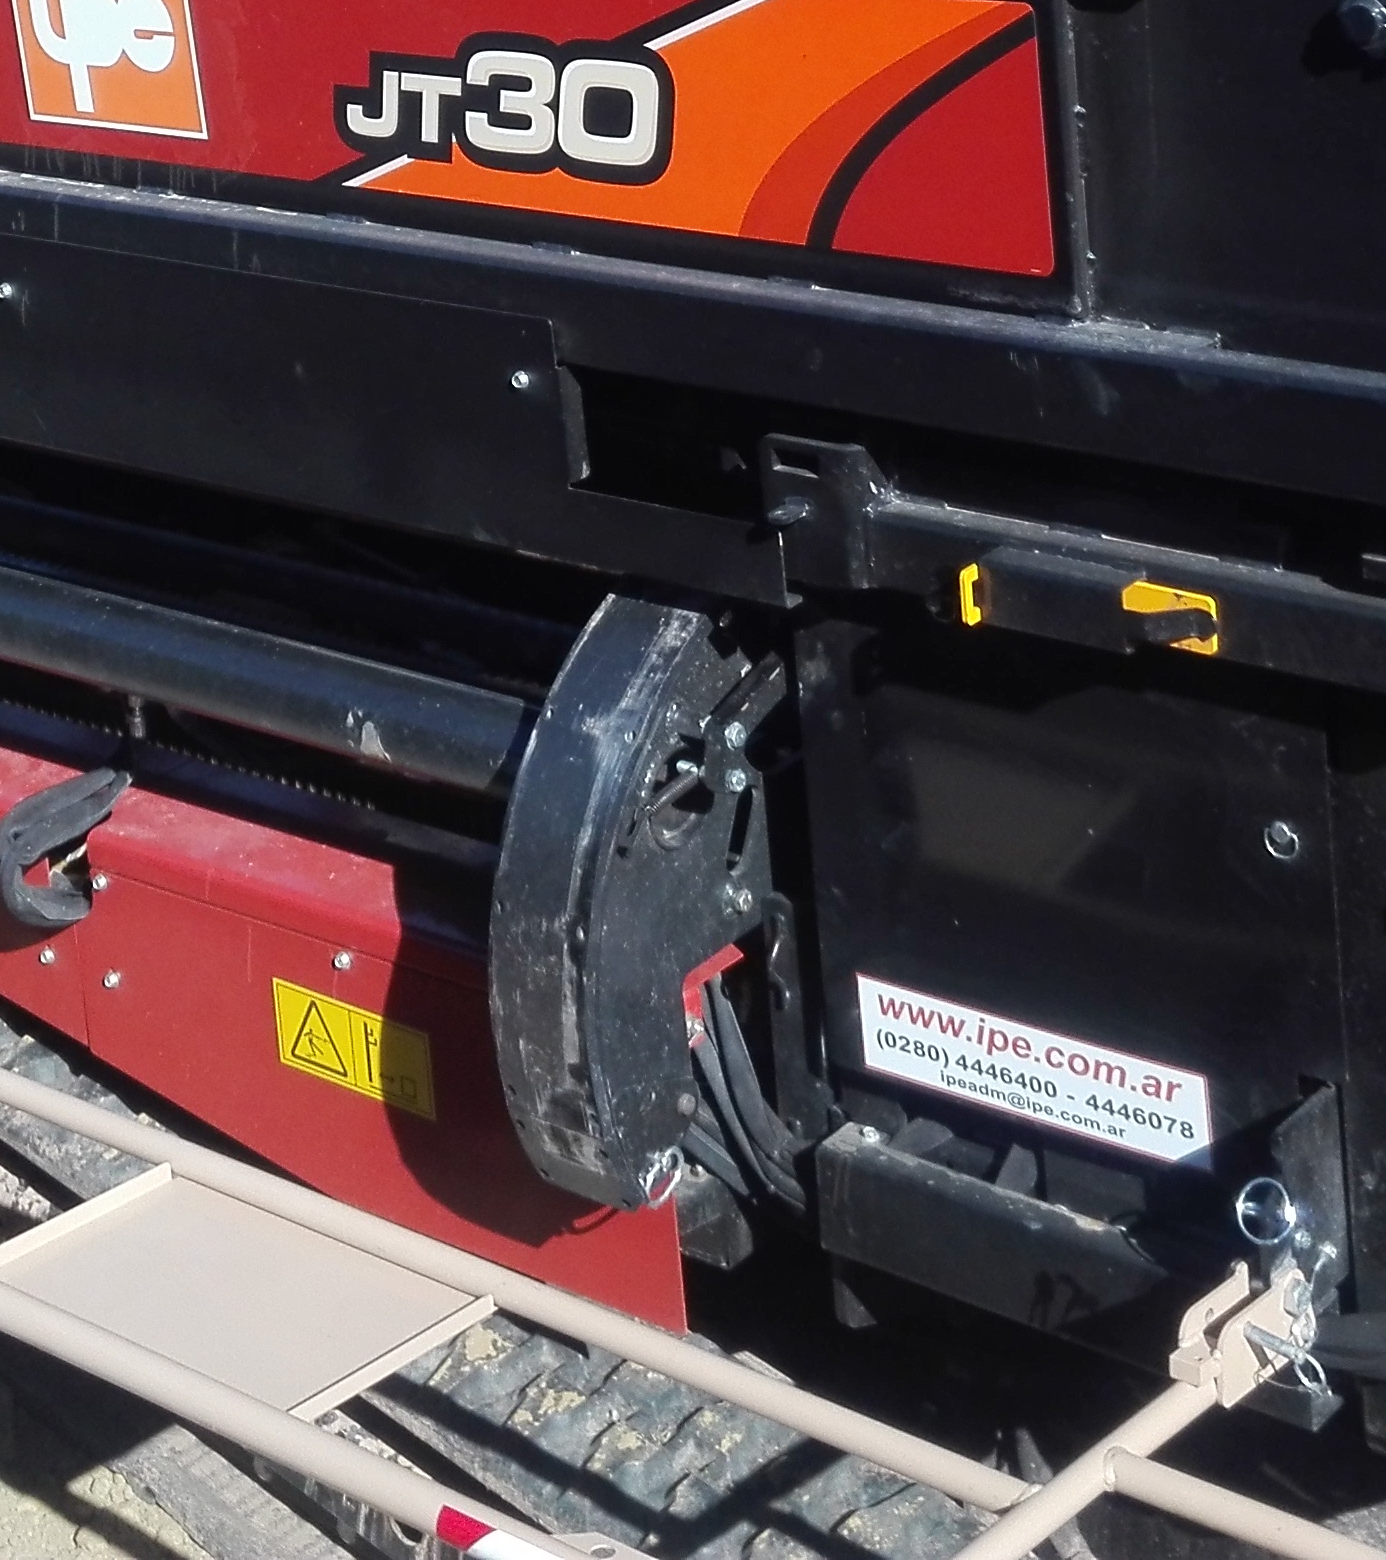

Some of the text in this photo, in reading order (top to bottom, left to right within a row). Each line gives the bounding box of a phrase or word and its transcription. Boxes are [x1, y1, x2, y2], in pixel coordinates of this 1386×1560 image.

[344, 48, 661, 167] JT30
[876, 993, 1184, 1103] www.ipe.com.ar
[876, 1028, 950, 1069] (0280)
[954, 1054, 1058, 1099] 4446400
[1085, 1093, 1195, 1140] 4446078
[939, 1069, 1127, 1139] ipeadm@ipe.com.ar
